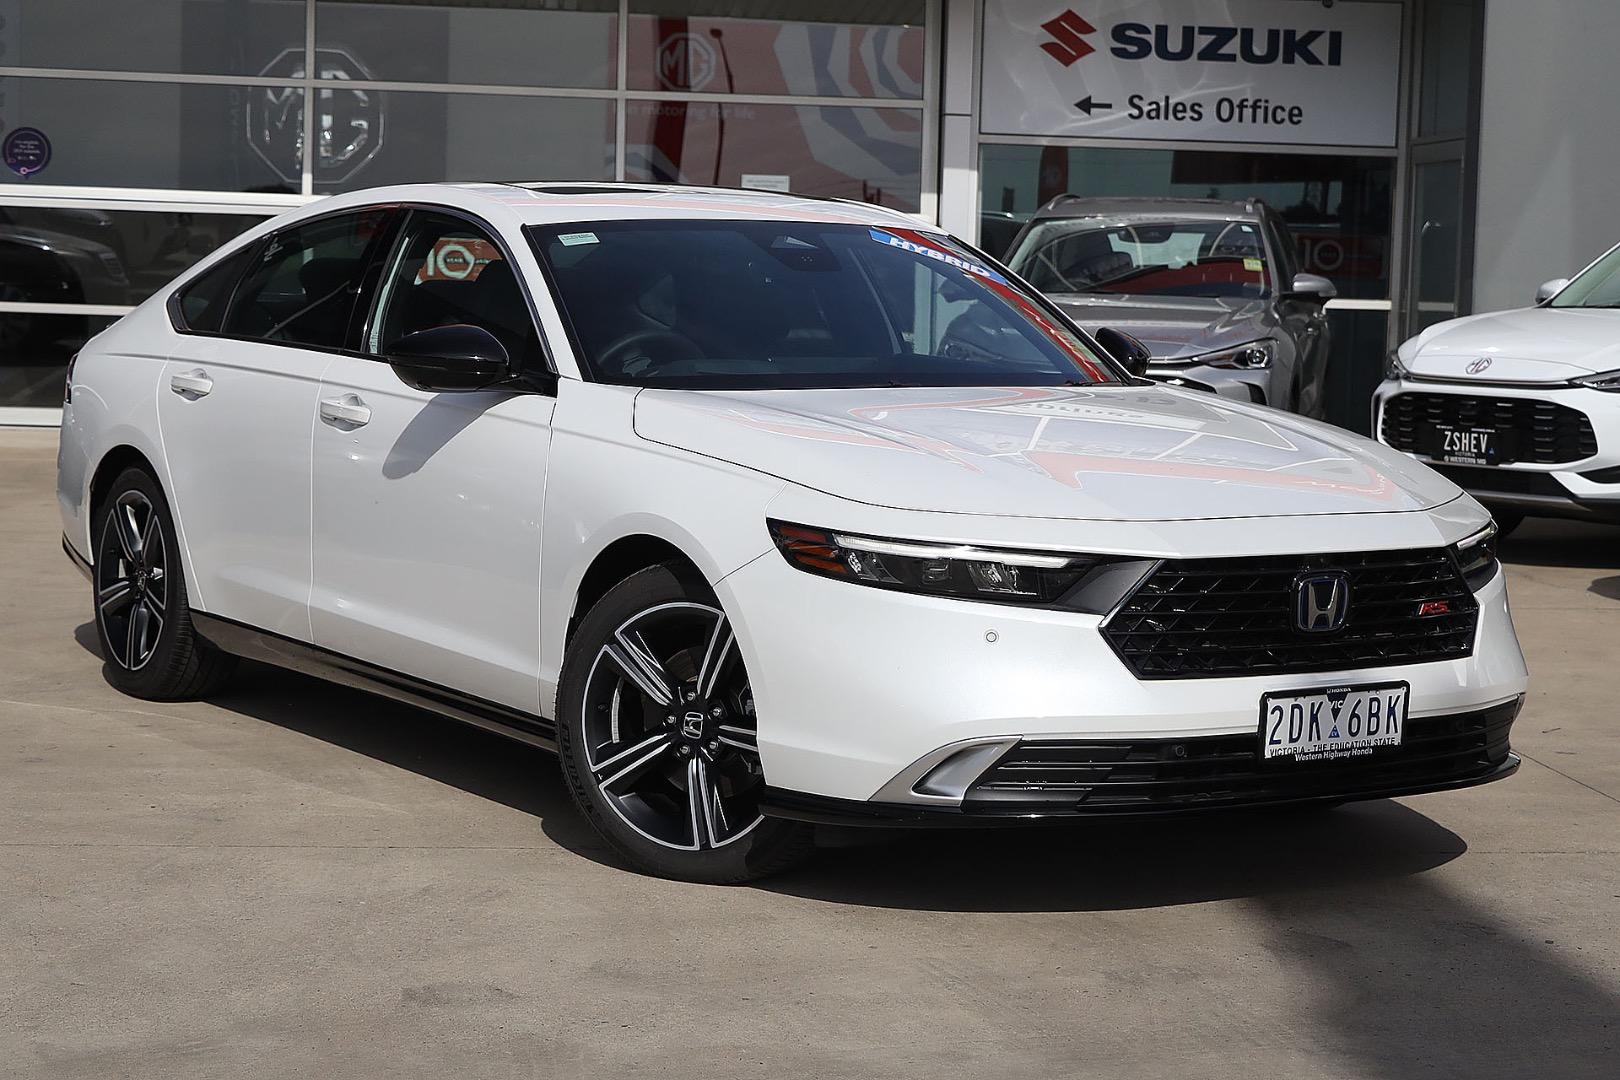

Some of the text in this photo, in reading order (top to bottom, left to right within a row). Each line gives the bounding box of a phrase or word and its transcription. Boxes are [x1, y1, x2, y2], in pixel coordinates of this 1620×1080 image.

[1110, 22, 1342, 66] SUZUKI
[1127, 94, 1303, 125] Sales Office
[888, 236, 991, 278] HYBRID
[1443, 431, 1488, 453] ZSHEV
[1419, 600, 1449, 615] RS
[1269, 694, 1401, 746] 2DK 6BK
[1269, 746, 1305, 757] VICTORIA
[1313, 743, 1327, 752] THE
[1330, 739, 1372, 750] EDUCATION
[1374, 737, 1396, 746] STATE
[1295, 747, 1373, 761] Western Highway Honda
